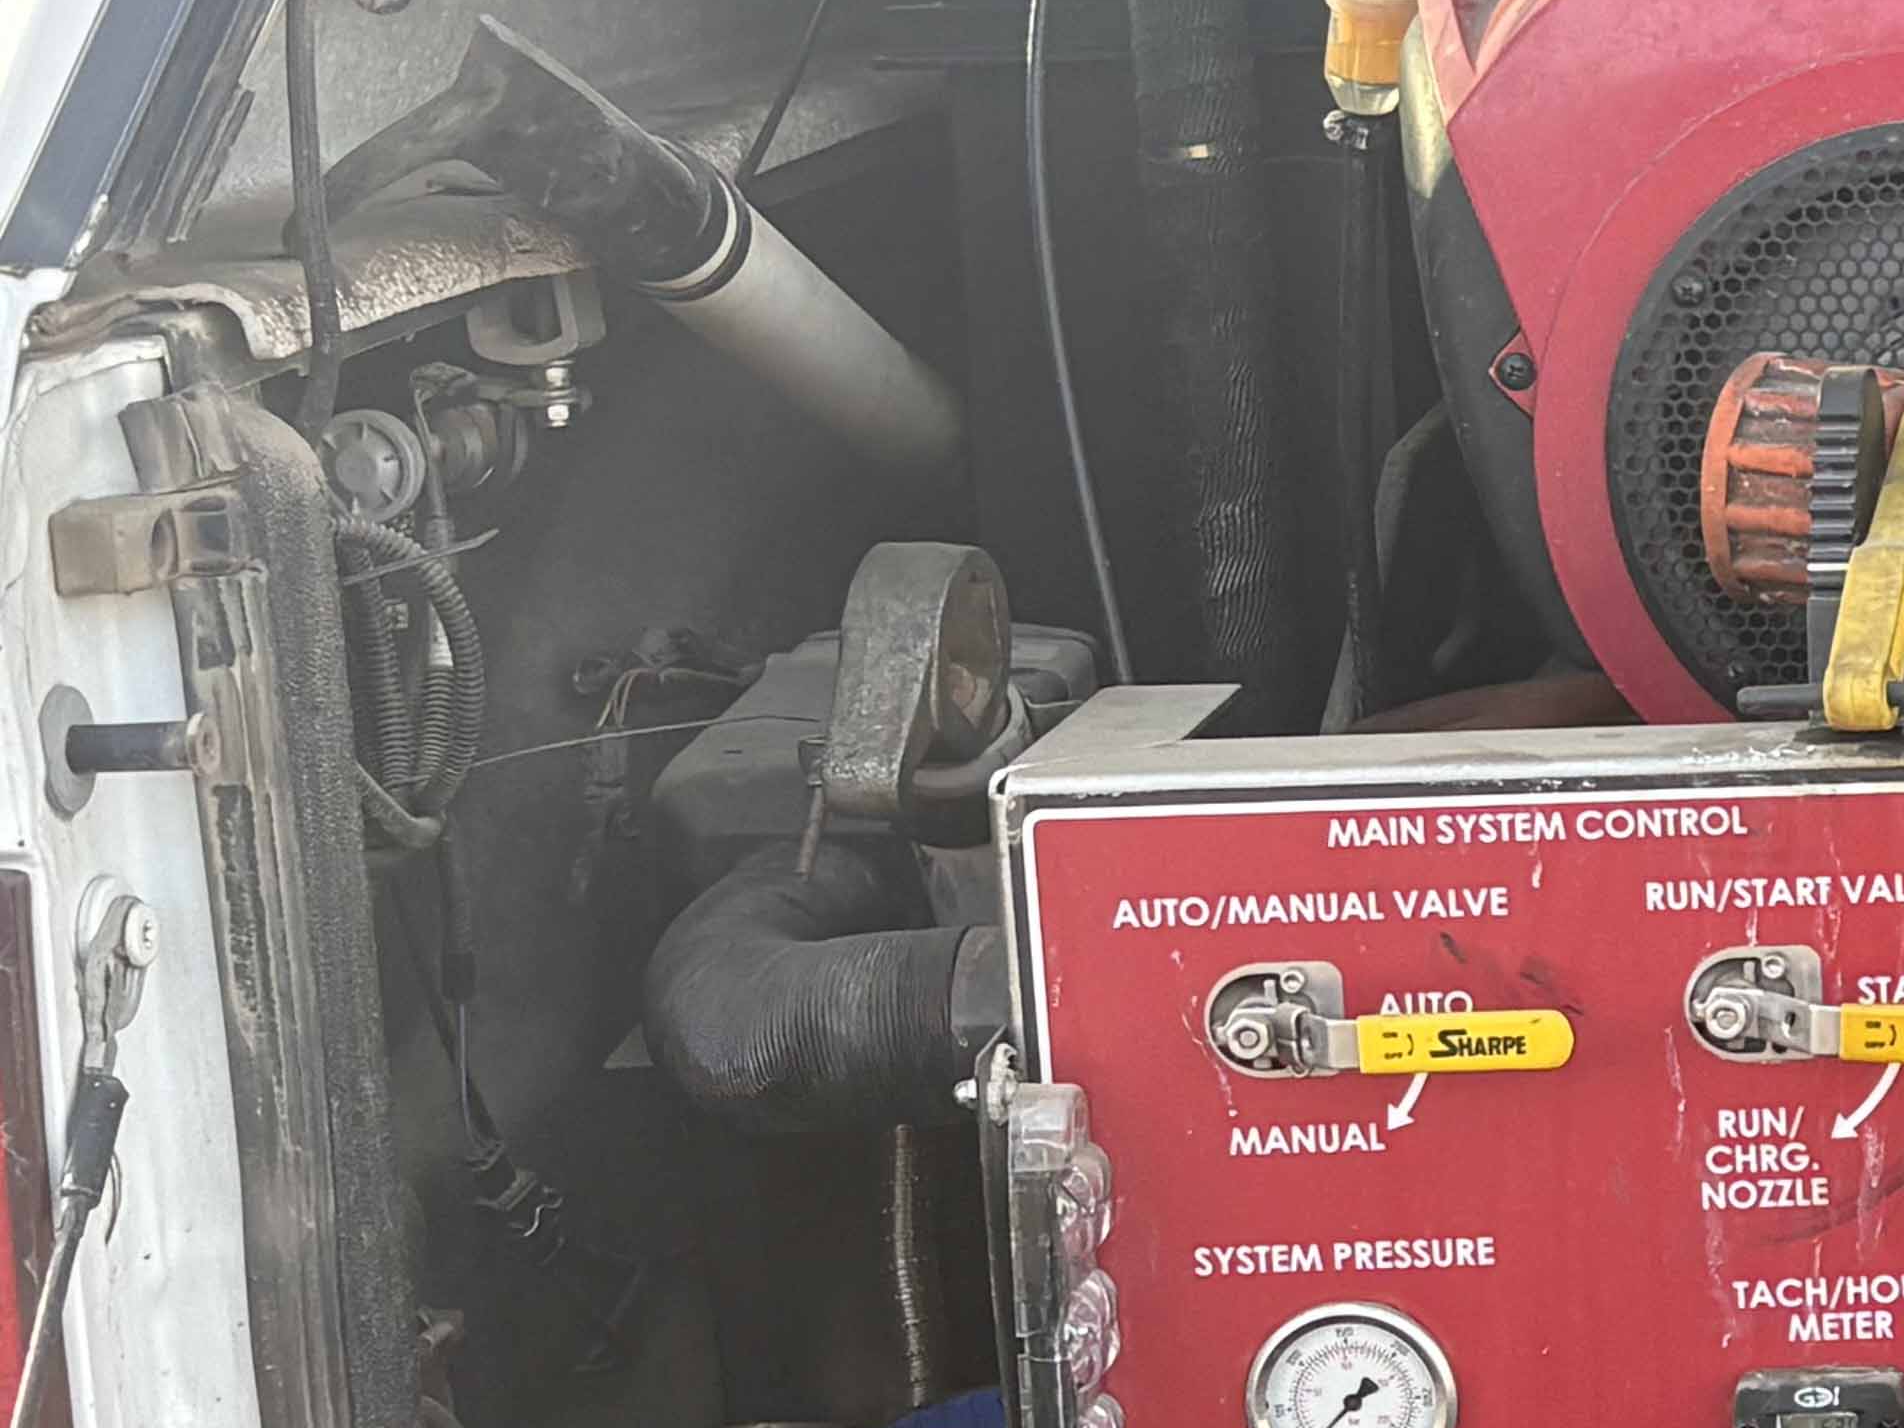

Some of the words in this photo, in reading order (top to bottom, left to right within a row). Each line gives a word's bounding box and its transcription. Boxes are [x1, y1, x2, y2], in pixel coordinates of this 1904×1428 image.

[1327, 814, 1425, 848] MAIN
[1435, 810, 1570, 844] SYSTEM
[1575, 804, 1748, 841] CONTROL
[1113, 888, 1385, 932] AUTO/MANUAL
[1398, 884, 1509, 920] VALVE
[1645, 874, 1833, 914] RUN/START
[1380, 990, 1473, 1015] AUTO
[1229, 1122, 1387, 1157] MANUAL
[1717, 1105, 1805, 1140] RUN/
[1705, 1143, 1820, 1175] CHRG.
[1701, 1177, 1829, 1210] NOZZLE
[1193, 1242, 1323, 1276] SYSTEM
[1333, 1236, 1495, 1272] PRESSURE
[1787, 1309, 1895, 1344] METER
